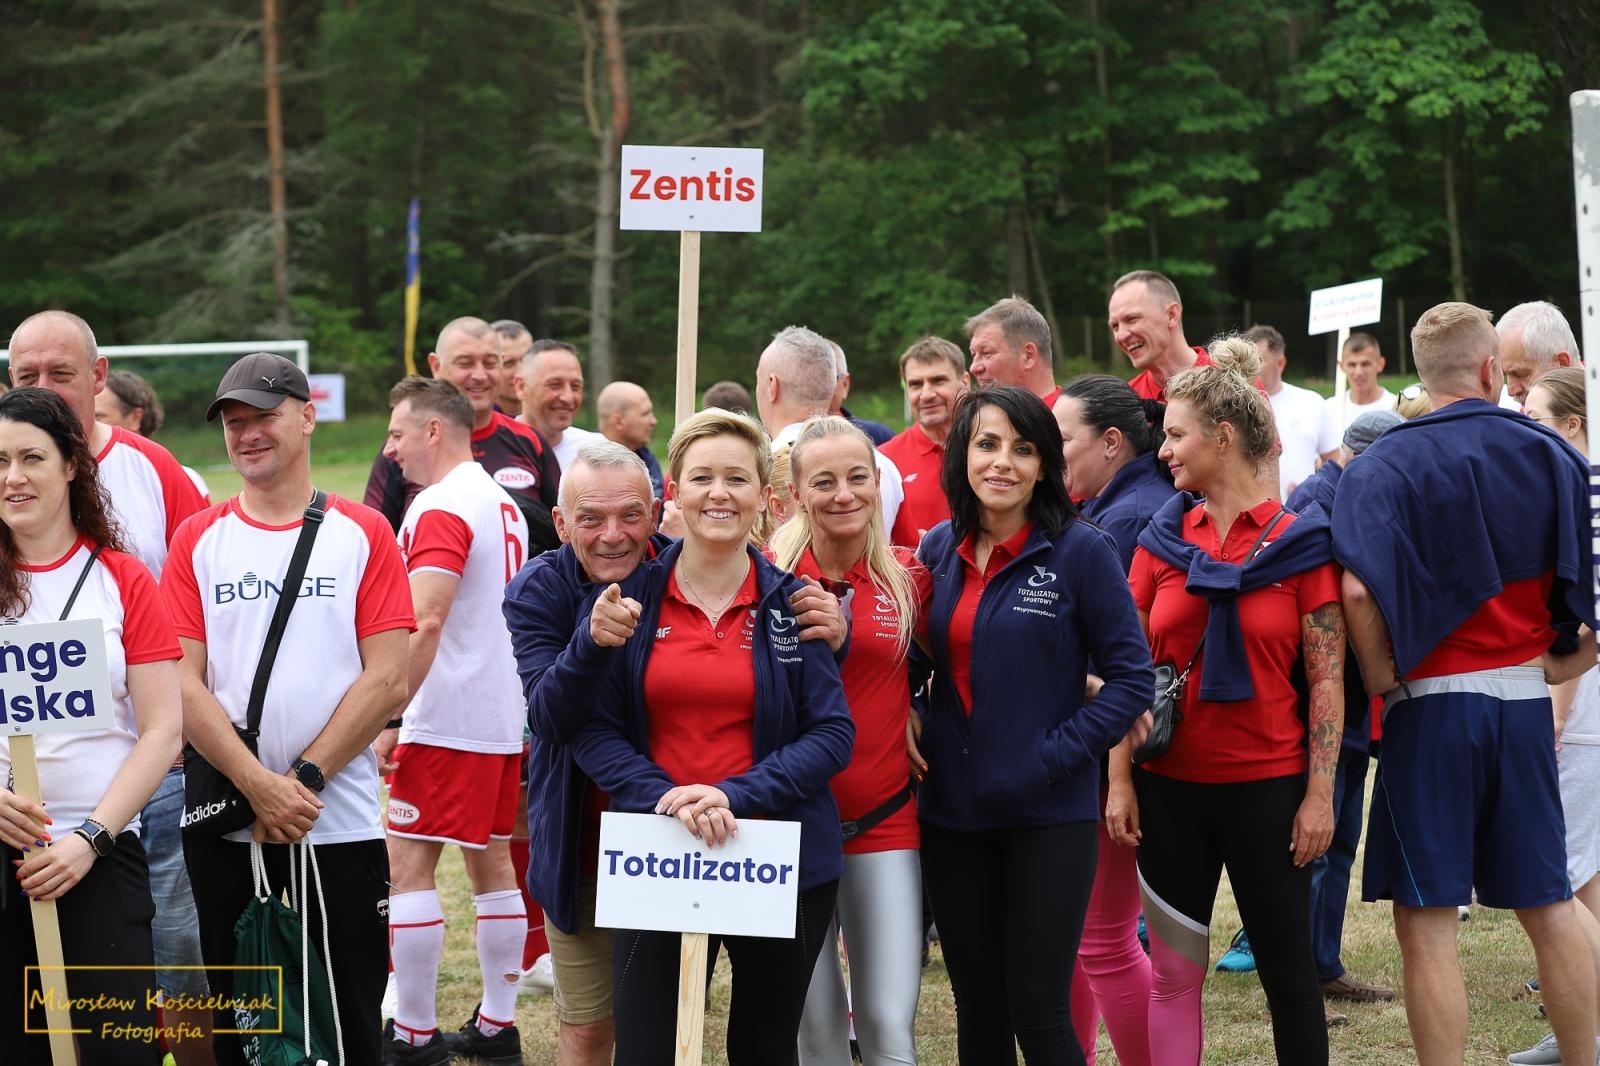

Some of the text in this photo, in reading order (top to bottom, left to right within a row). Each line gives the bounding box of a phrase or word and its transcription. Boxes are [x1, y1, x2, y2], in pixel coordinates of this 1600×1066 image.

[630, 167, 755, 202] Zentis
[1018, 588, 1060, 600] TOTALIZATOR
[1023, 597, 1053, 605] SPORTOWY
[0, 639, 87, 682] nge
[186, 800, 227, 826] adidas
[604, 850, 793, 885] Totalizator
